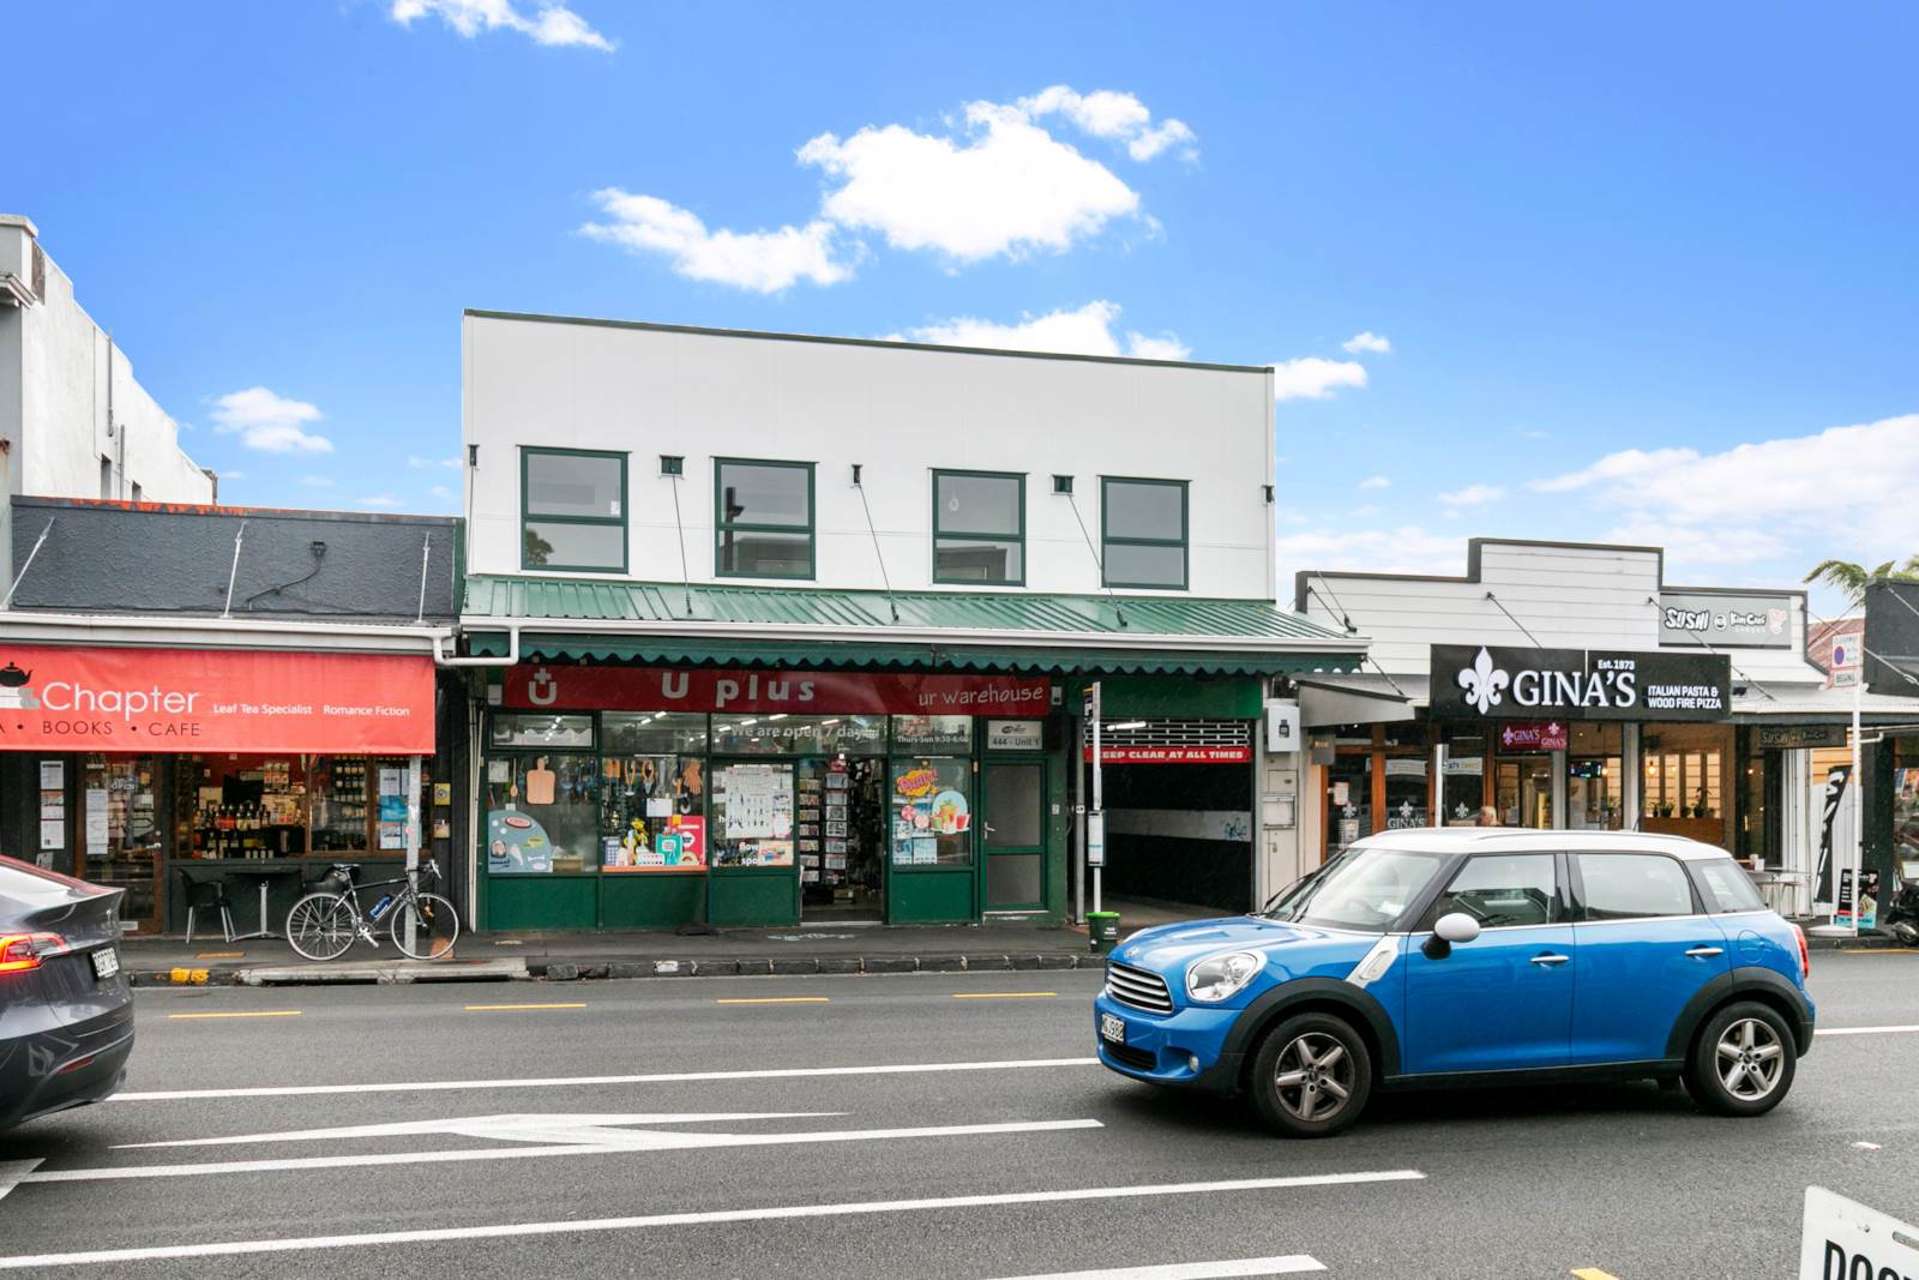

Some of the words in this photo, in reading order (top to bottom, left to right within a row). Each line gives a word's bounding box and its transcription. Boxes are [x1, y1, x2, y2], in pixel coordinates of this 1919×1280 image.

[1664, 606, 1710, 631] SUSHI
[662, 672, 689, 699] U
[715, 673, 815, 708] plus
[919, 692, 937, 706] ur
[942, 683, 1044, 704] warehouse
[1513, 670, 1637, 708] GINA'S
[1647, 684, 1681, 697] ITALIAN
[1682, 685, 1709, 697] PASTA
[42, 681, 200, 722] Chapter
[1648, 697, 1674, 709] WOOD
[1676, 698, 1696, 709] FIRE
[1697, 698, 1722, 709] PIZZA
[213, 703, 237, 714] Leaf
[240, 704, 258, 715] Tea
[261, 704, 313, 717] Specialist
[323, 704, 373, 716] Romance
[374, 705, 410, 717] Fiction
[42, 720, 113, 735] BOOKS
[148, 722, 200, 737] CAFE
[757, 727, 777, 737] are
[783, 725, 821, 739] open
[1128, 751, 1166, 759] CLEAR
[1168, 751, 1184, 759] AT
[1186, 751, 1206, 759] ALL
[1209, 751, 1243, 759] TIMES
